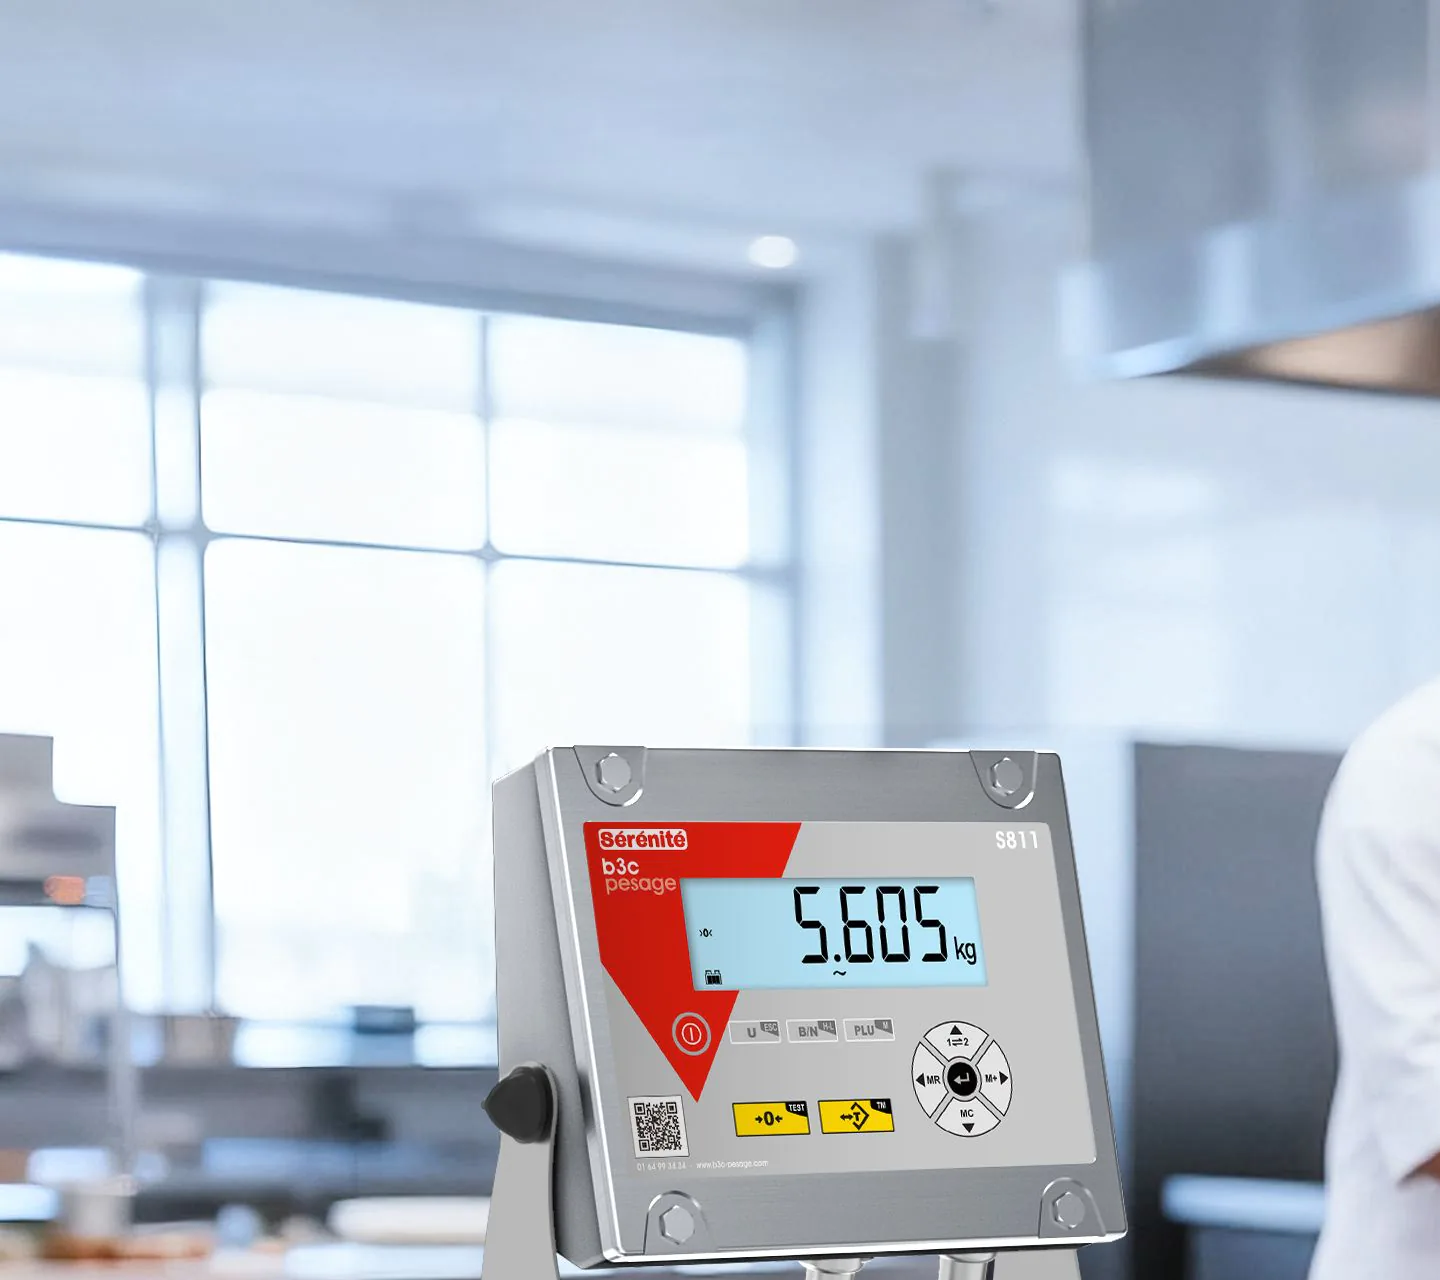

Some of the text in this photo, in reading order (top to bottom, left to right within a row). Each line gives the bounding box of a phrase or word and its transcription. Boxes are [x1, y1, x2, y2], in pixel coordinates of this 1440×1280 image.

[600, 830, 685, 848] Sérénité
[995, 830, 1038, 849] S811
[602, 857, 639, 875] b3c
[605, 877, 677, 895] pesage
[793, 886, 977, 965] 5.605 kg
[747, 1027, 757, 1038] U
[764, 1022, 778, 1032] ESC
[799, 1026, 818, 1037] B/N
[854, 1024, 875, 1036] PLU
[926, 1075, 941, 1085] MR
[985, 1074, 998, 1083] M+
[788, 1103, 805, 1112] TEST
[960, 1109, 974, 1118] MC
